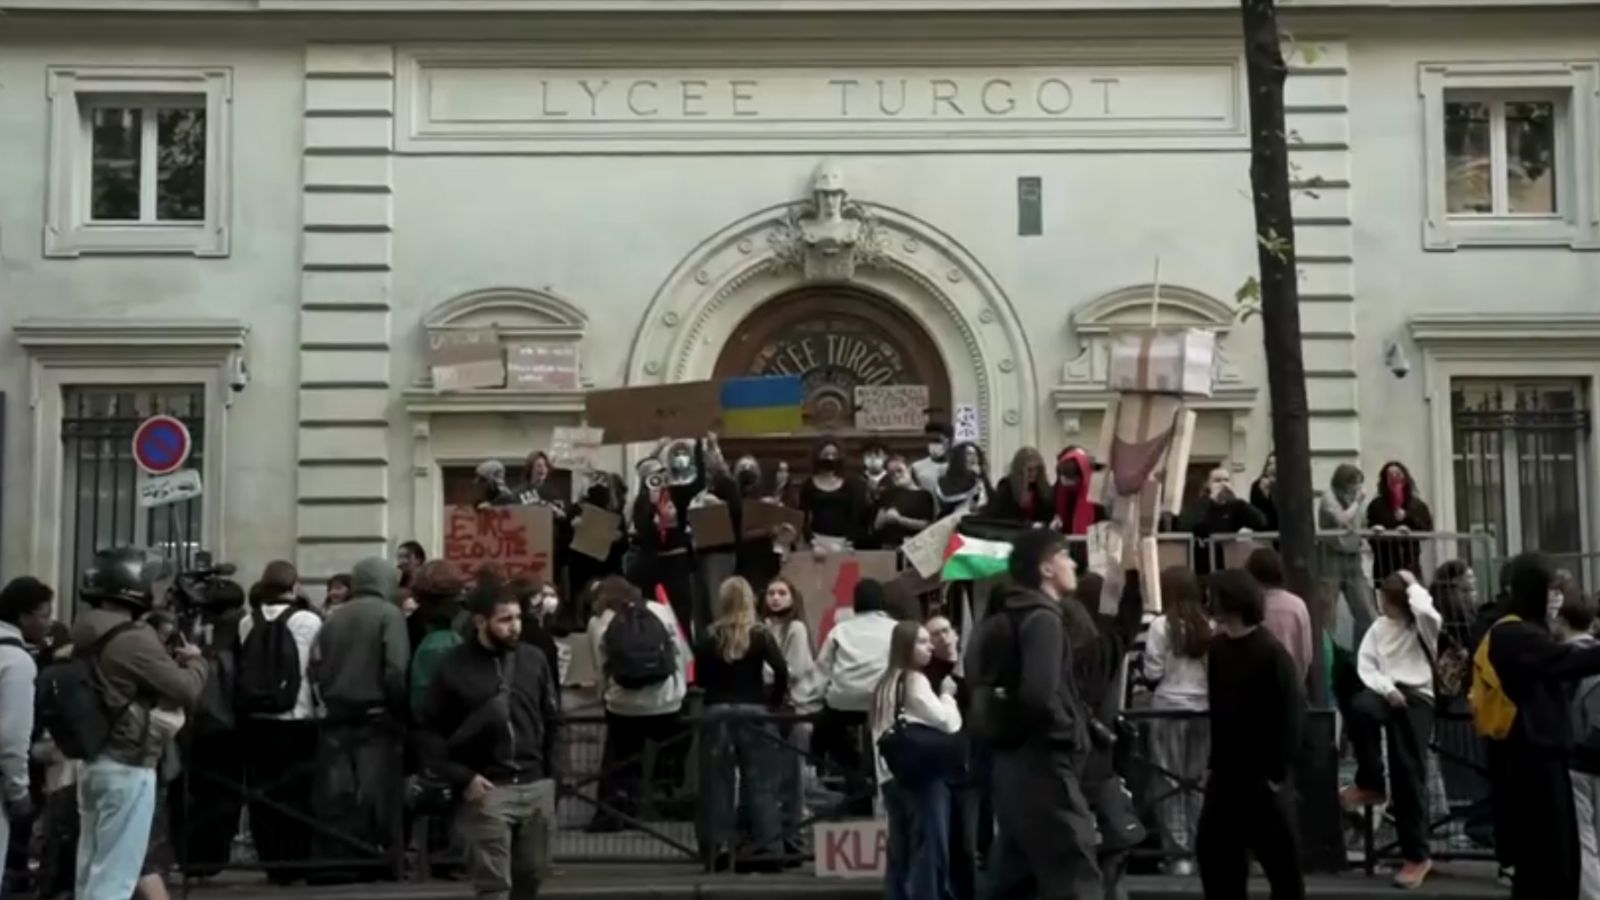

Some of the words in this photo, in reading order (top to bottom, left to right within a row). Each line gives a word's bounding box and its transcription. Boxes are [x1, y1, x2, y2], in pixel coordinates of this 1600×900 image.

[540, 79, 759, 116] LYCEE
[828, 78, 1120, 116] TURGOT
[826, 334, 893, 385] TURGO
